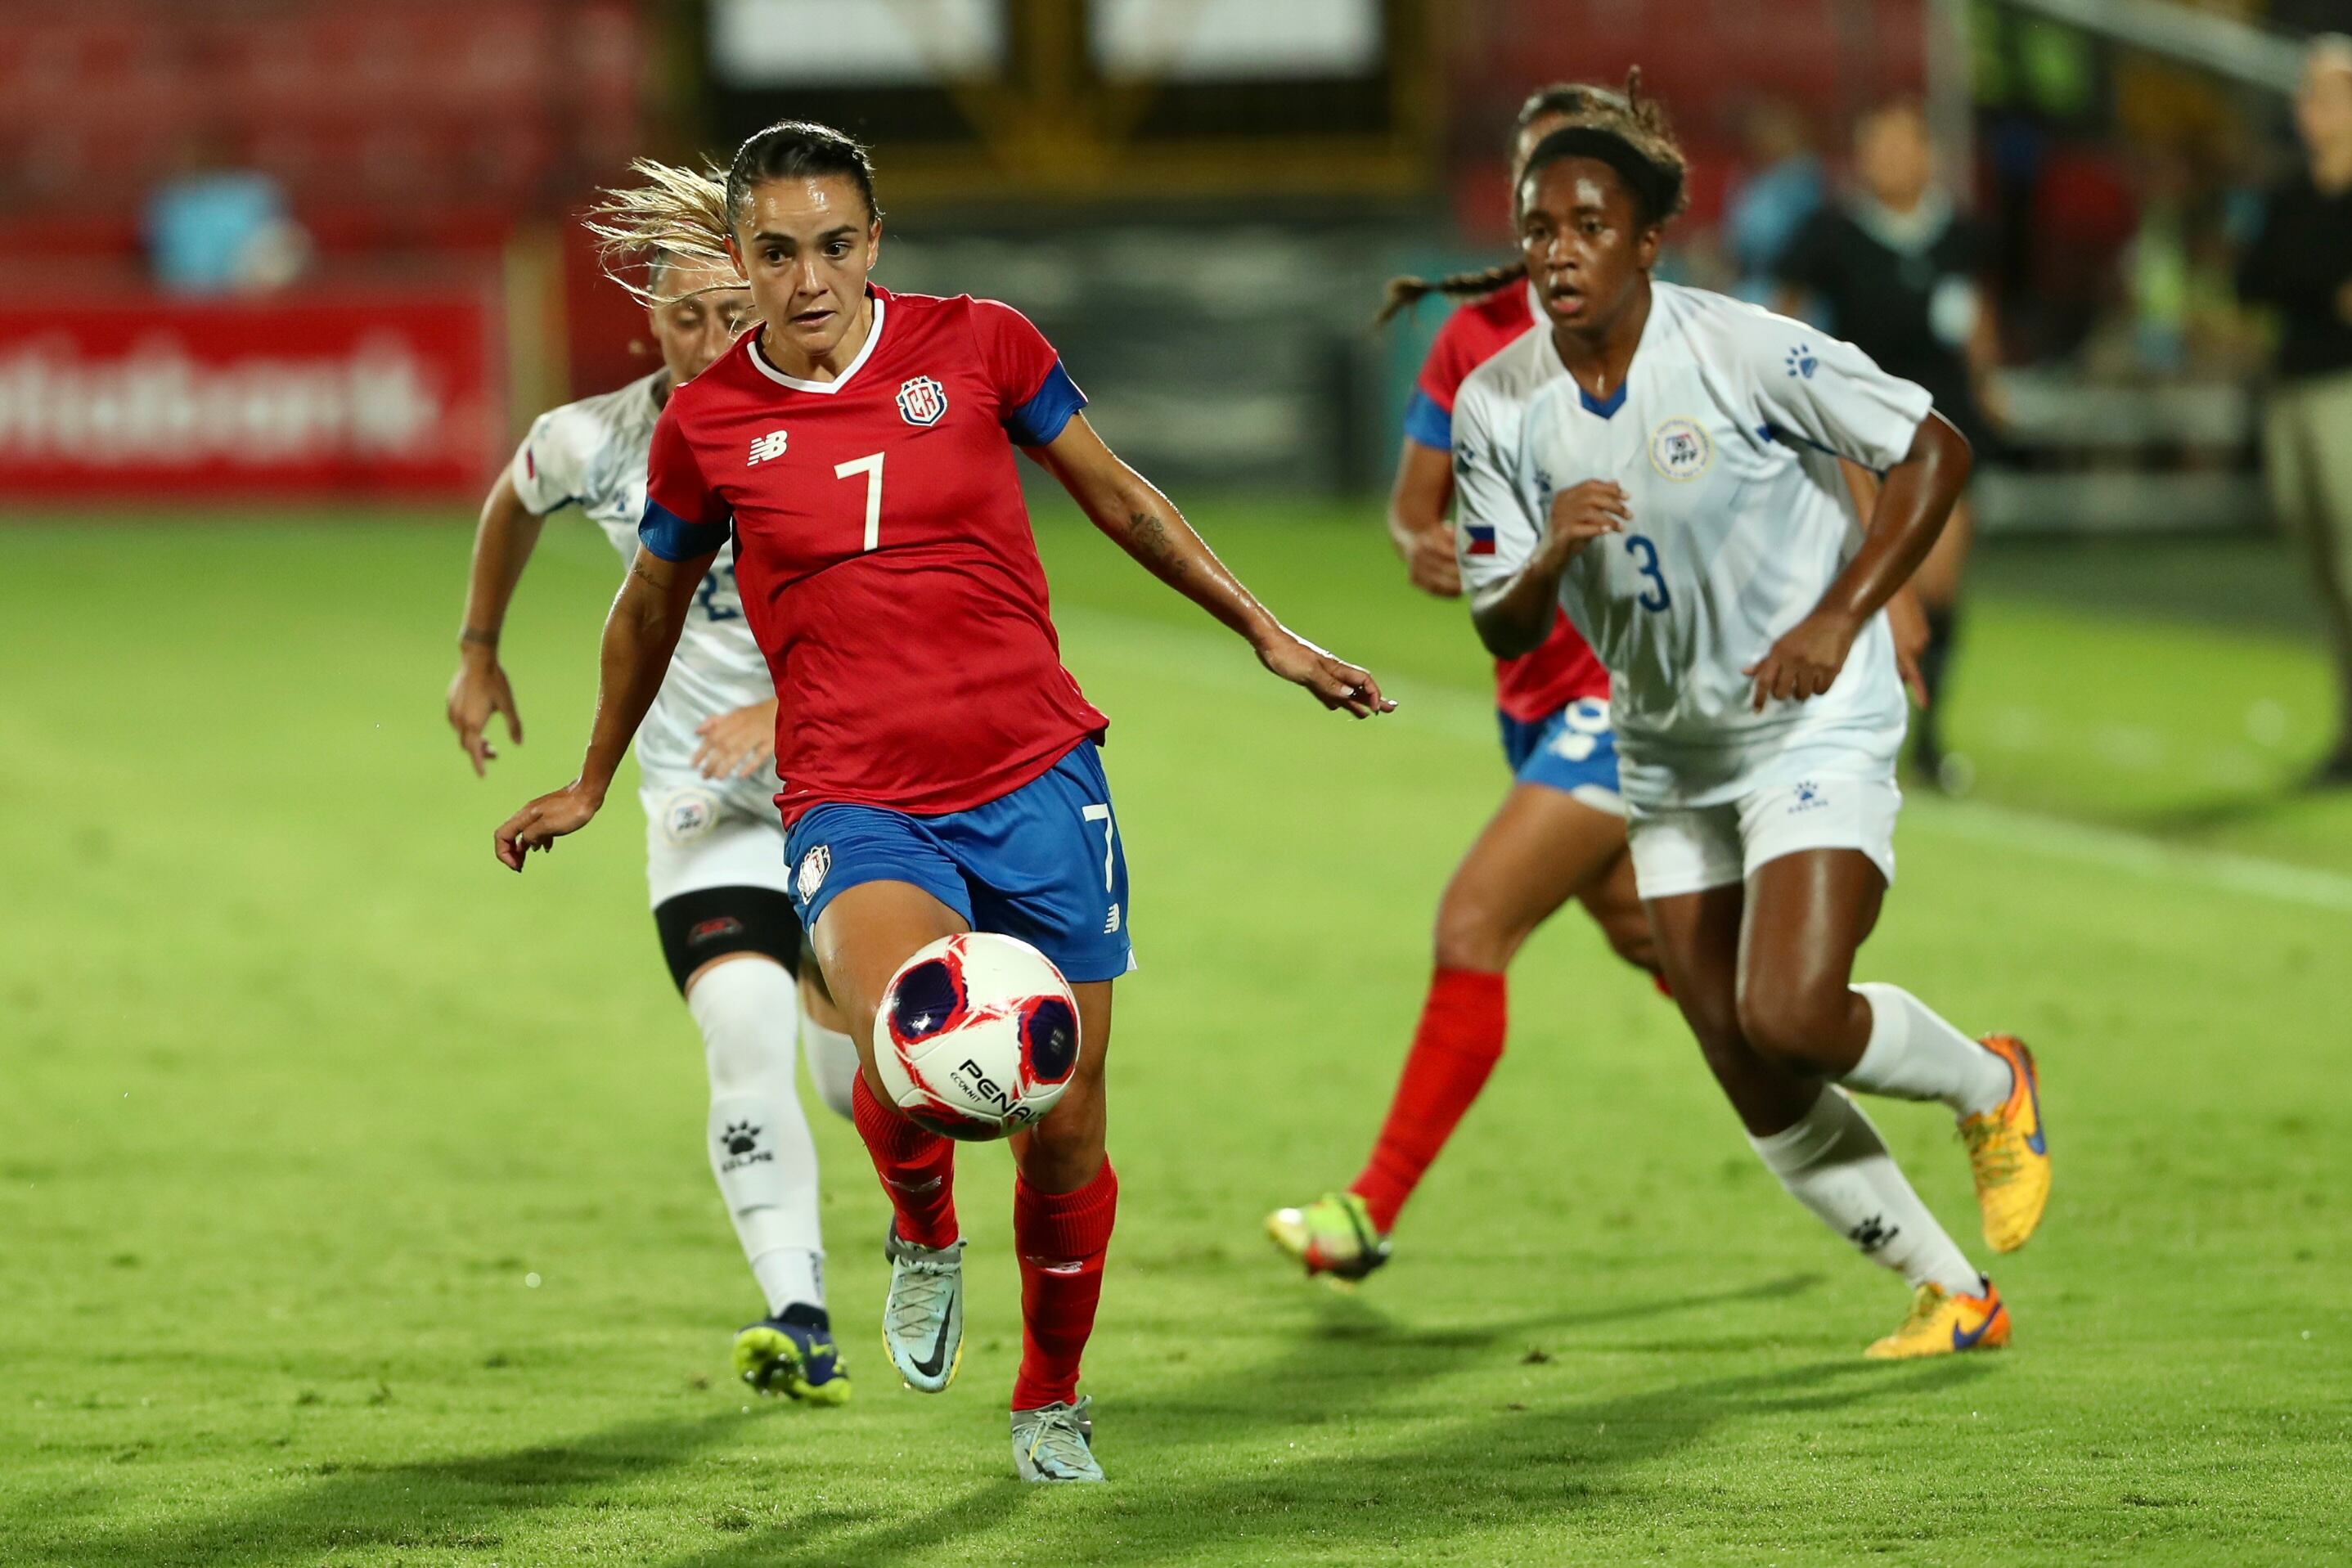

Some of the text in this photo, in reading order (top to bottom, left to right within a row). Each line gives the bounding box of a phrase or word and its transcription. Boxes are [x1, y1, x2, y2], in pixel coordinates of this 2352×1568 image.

[834, 452, 885, 551] 7
[1626, 535, 1671, 612] 3
[1082, 803, 1113, 893] 7
